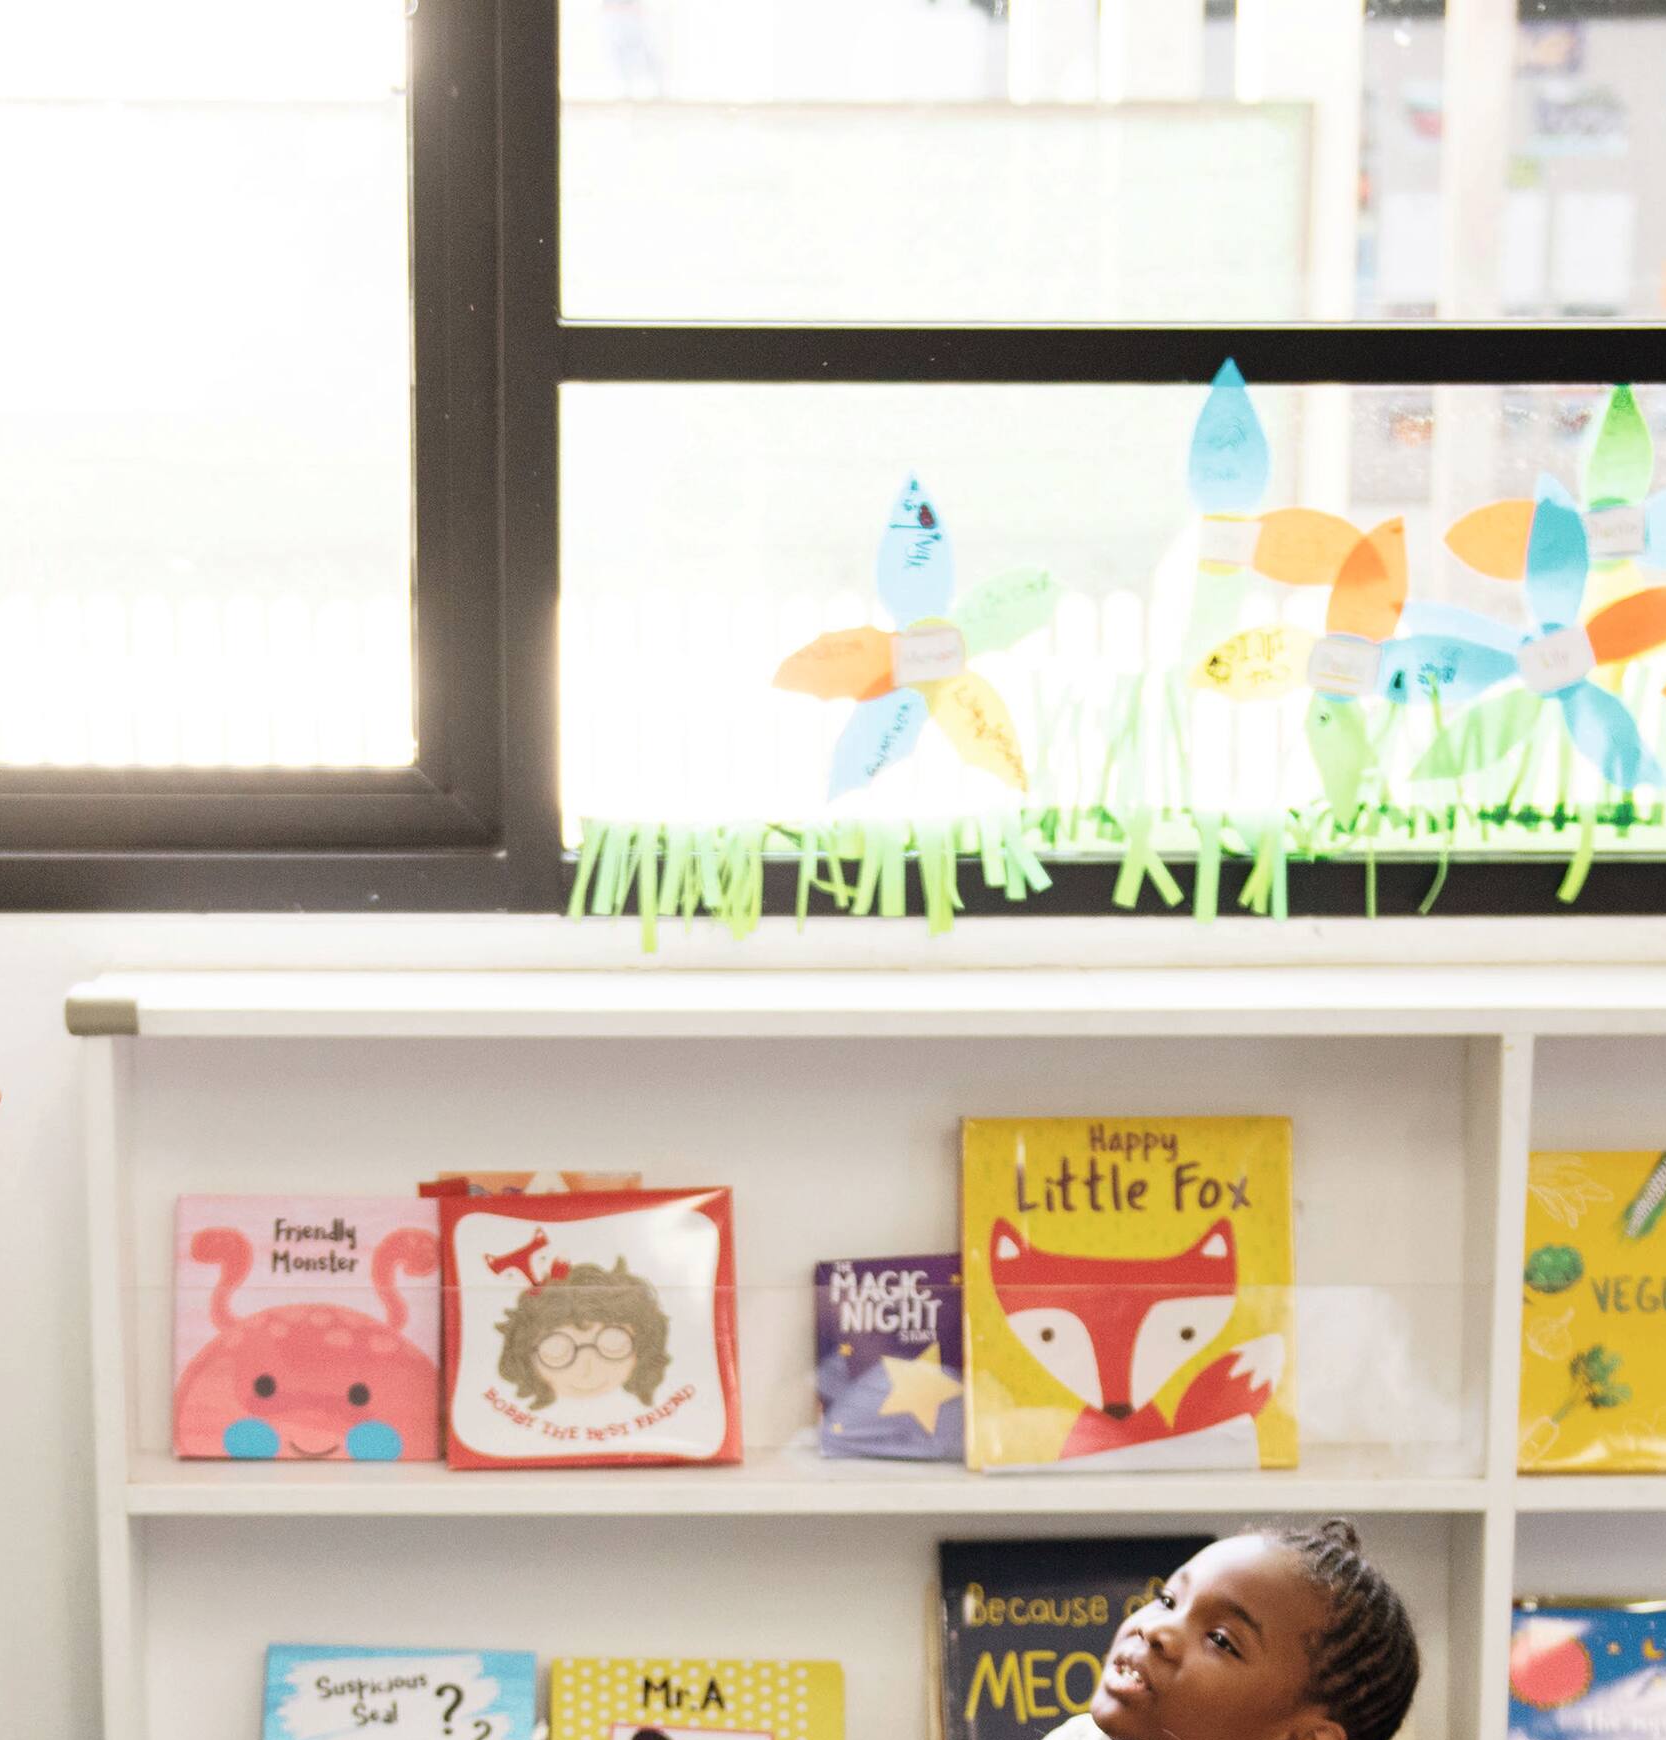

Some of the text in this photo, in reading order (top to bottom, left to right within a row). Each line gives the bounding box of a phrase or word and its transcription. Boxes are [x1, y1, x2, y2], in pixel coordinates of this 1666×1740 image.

[1088, 1124, 1179, 1162] Happy
[1016, 1156, 1251, 1213] Little Fox
[273, 1217, 358, 1249] Friendly
[271, 1250, 359, 1274] Monster
[829, 1269, 933, 1305] MAGIC
[839, 1299, 943, 1334] NIGHT
[542, 1420, 580, 1441] THE
[634, 1383, 696, 1430] FRIEND
[966, 1582, 1110, 1627] Because
[314, 1673, 429, 1702] Suspicious
[965, 1650, 1109, 1725] MEO
[351, 1703, 399, 1727] Seal
